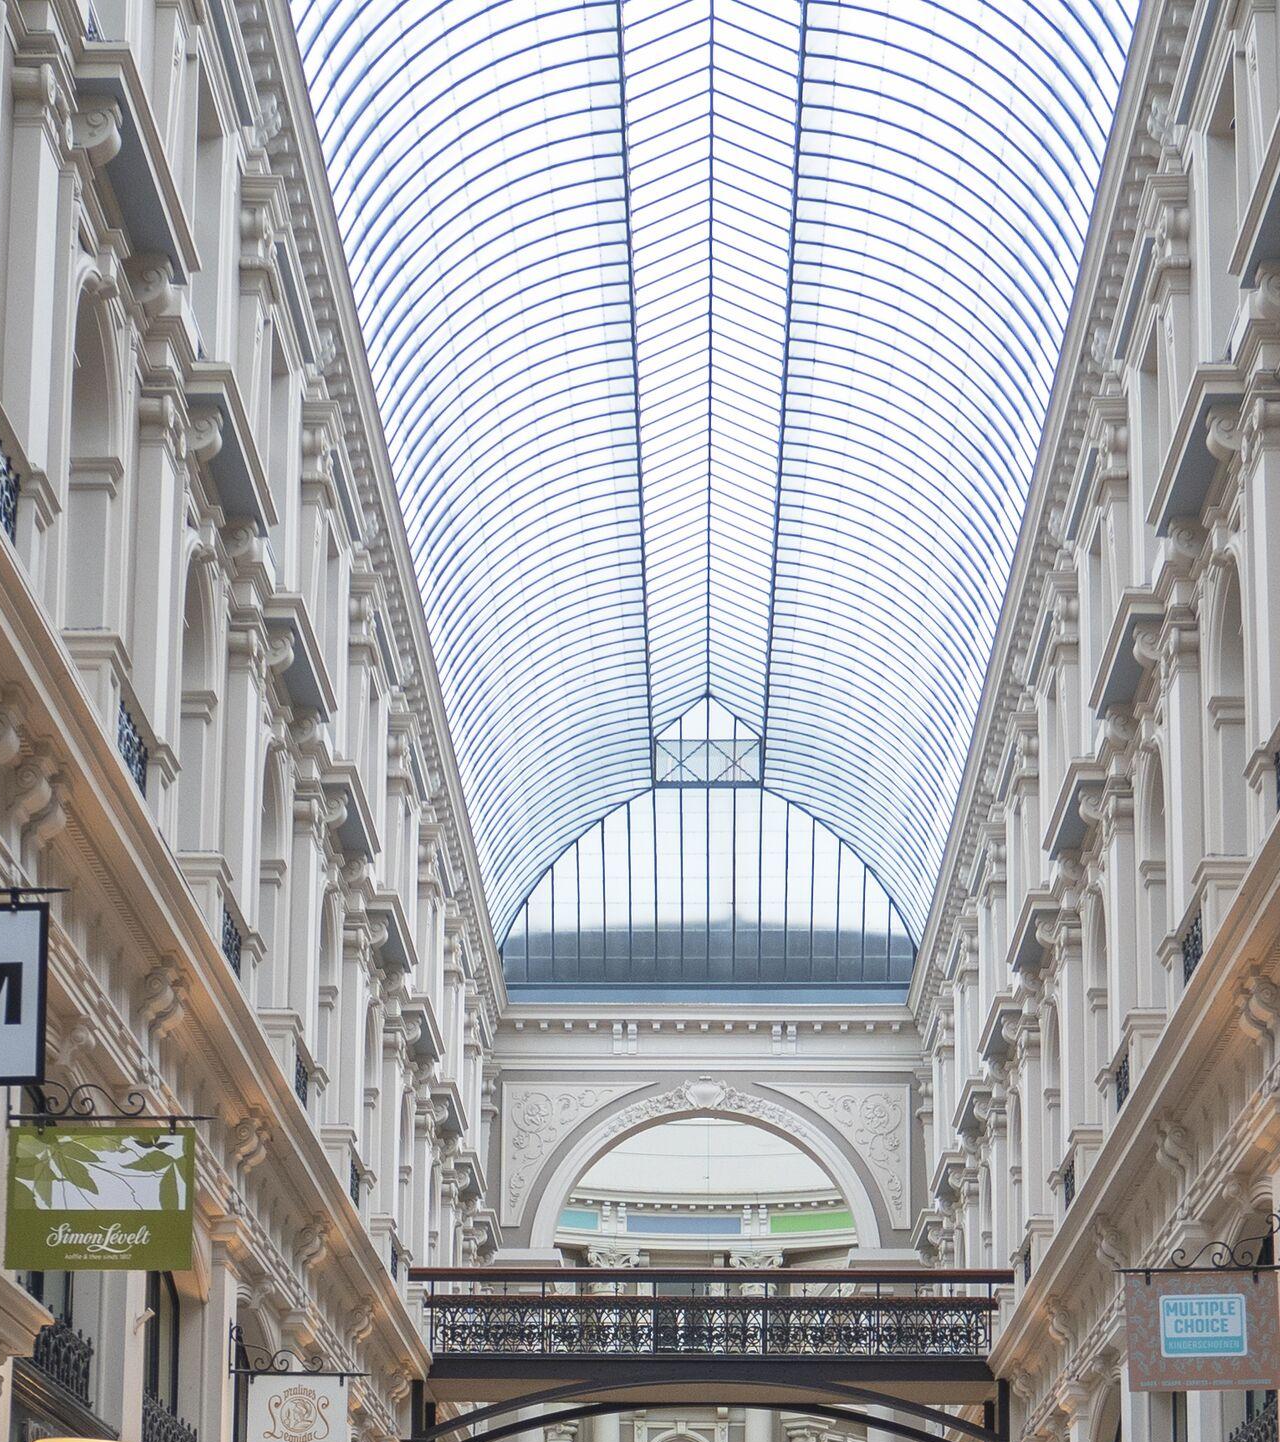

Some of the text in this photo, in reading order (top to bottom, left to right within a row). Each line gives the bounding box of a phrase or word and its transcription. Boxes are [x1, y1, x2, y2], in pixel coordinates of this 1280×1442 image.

[46, 1223, 104, 1247] Simon
[1165, 1301, 1236, 1317] MULTIPLE
[1174, 1318, 1229, 1334] CHOICE
